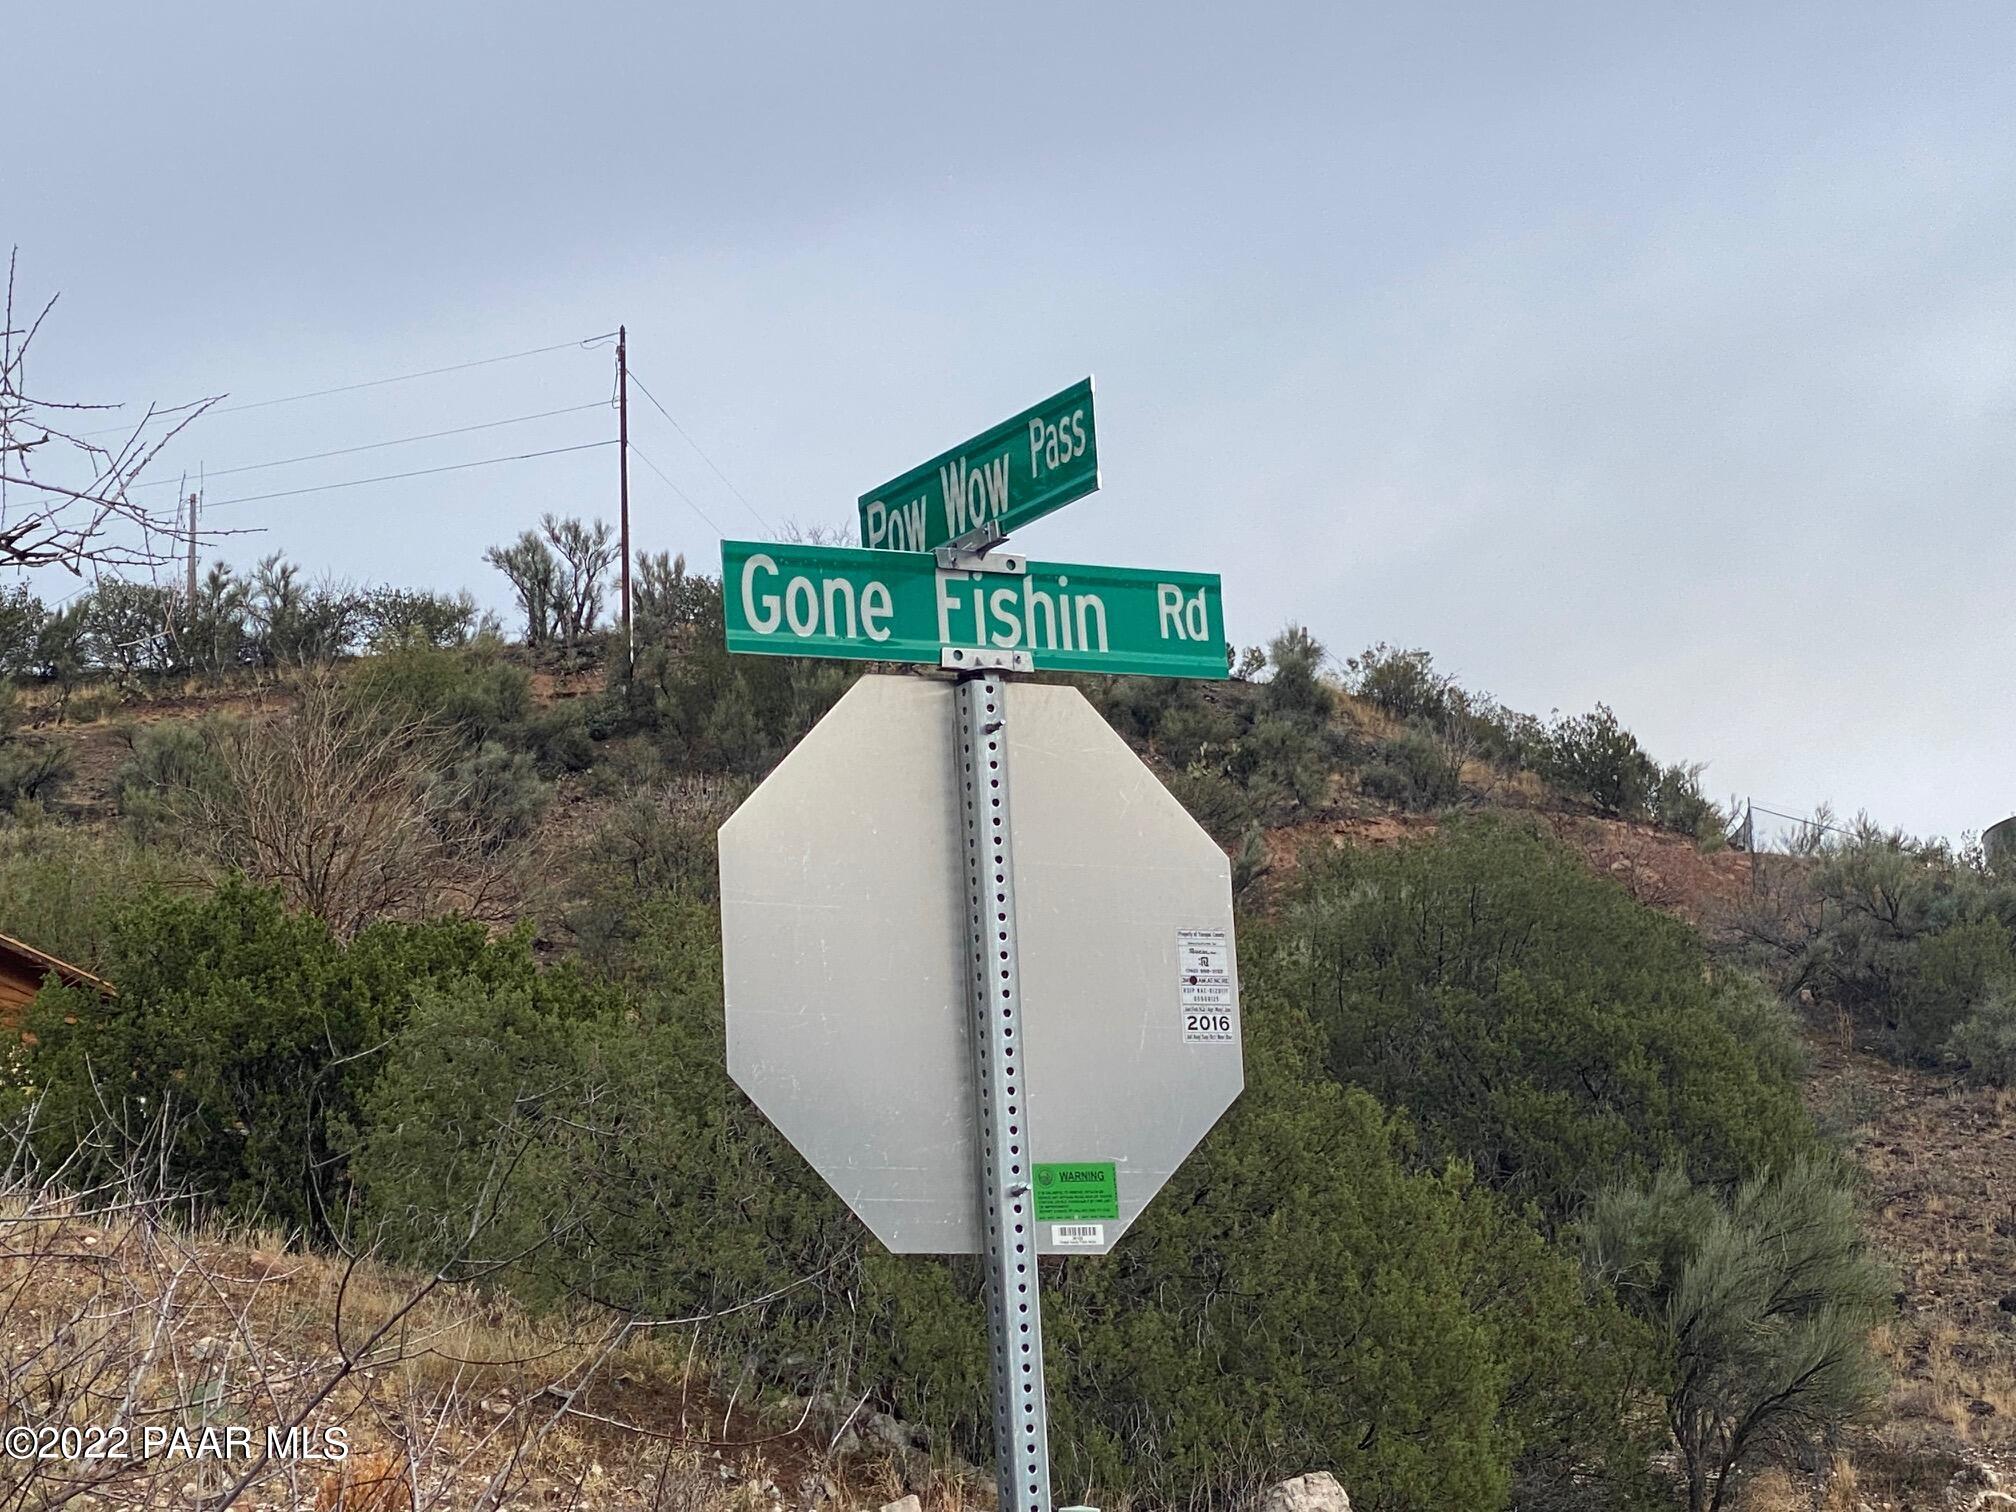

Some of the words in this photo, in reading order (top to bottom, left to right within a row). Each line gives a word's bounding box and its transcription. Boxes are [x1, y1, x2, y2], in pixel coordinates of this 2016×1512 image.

[867, 495, 926, 553] Pow
[940, 453, 1009, 538] Wow
[1028, 409, 1086, 479] Pass
[742, 553, 894, 642] Gone
[935, 570, 1109, 653] Fishin
[1157, 583, 1209, 642] Rd
[1187, 1015, 1230, 1031] 2016
[1059, 1170, 1105, 1183] WARNING
